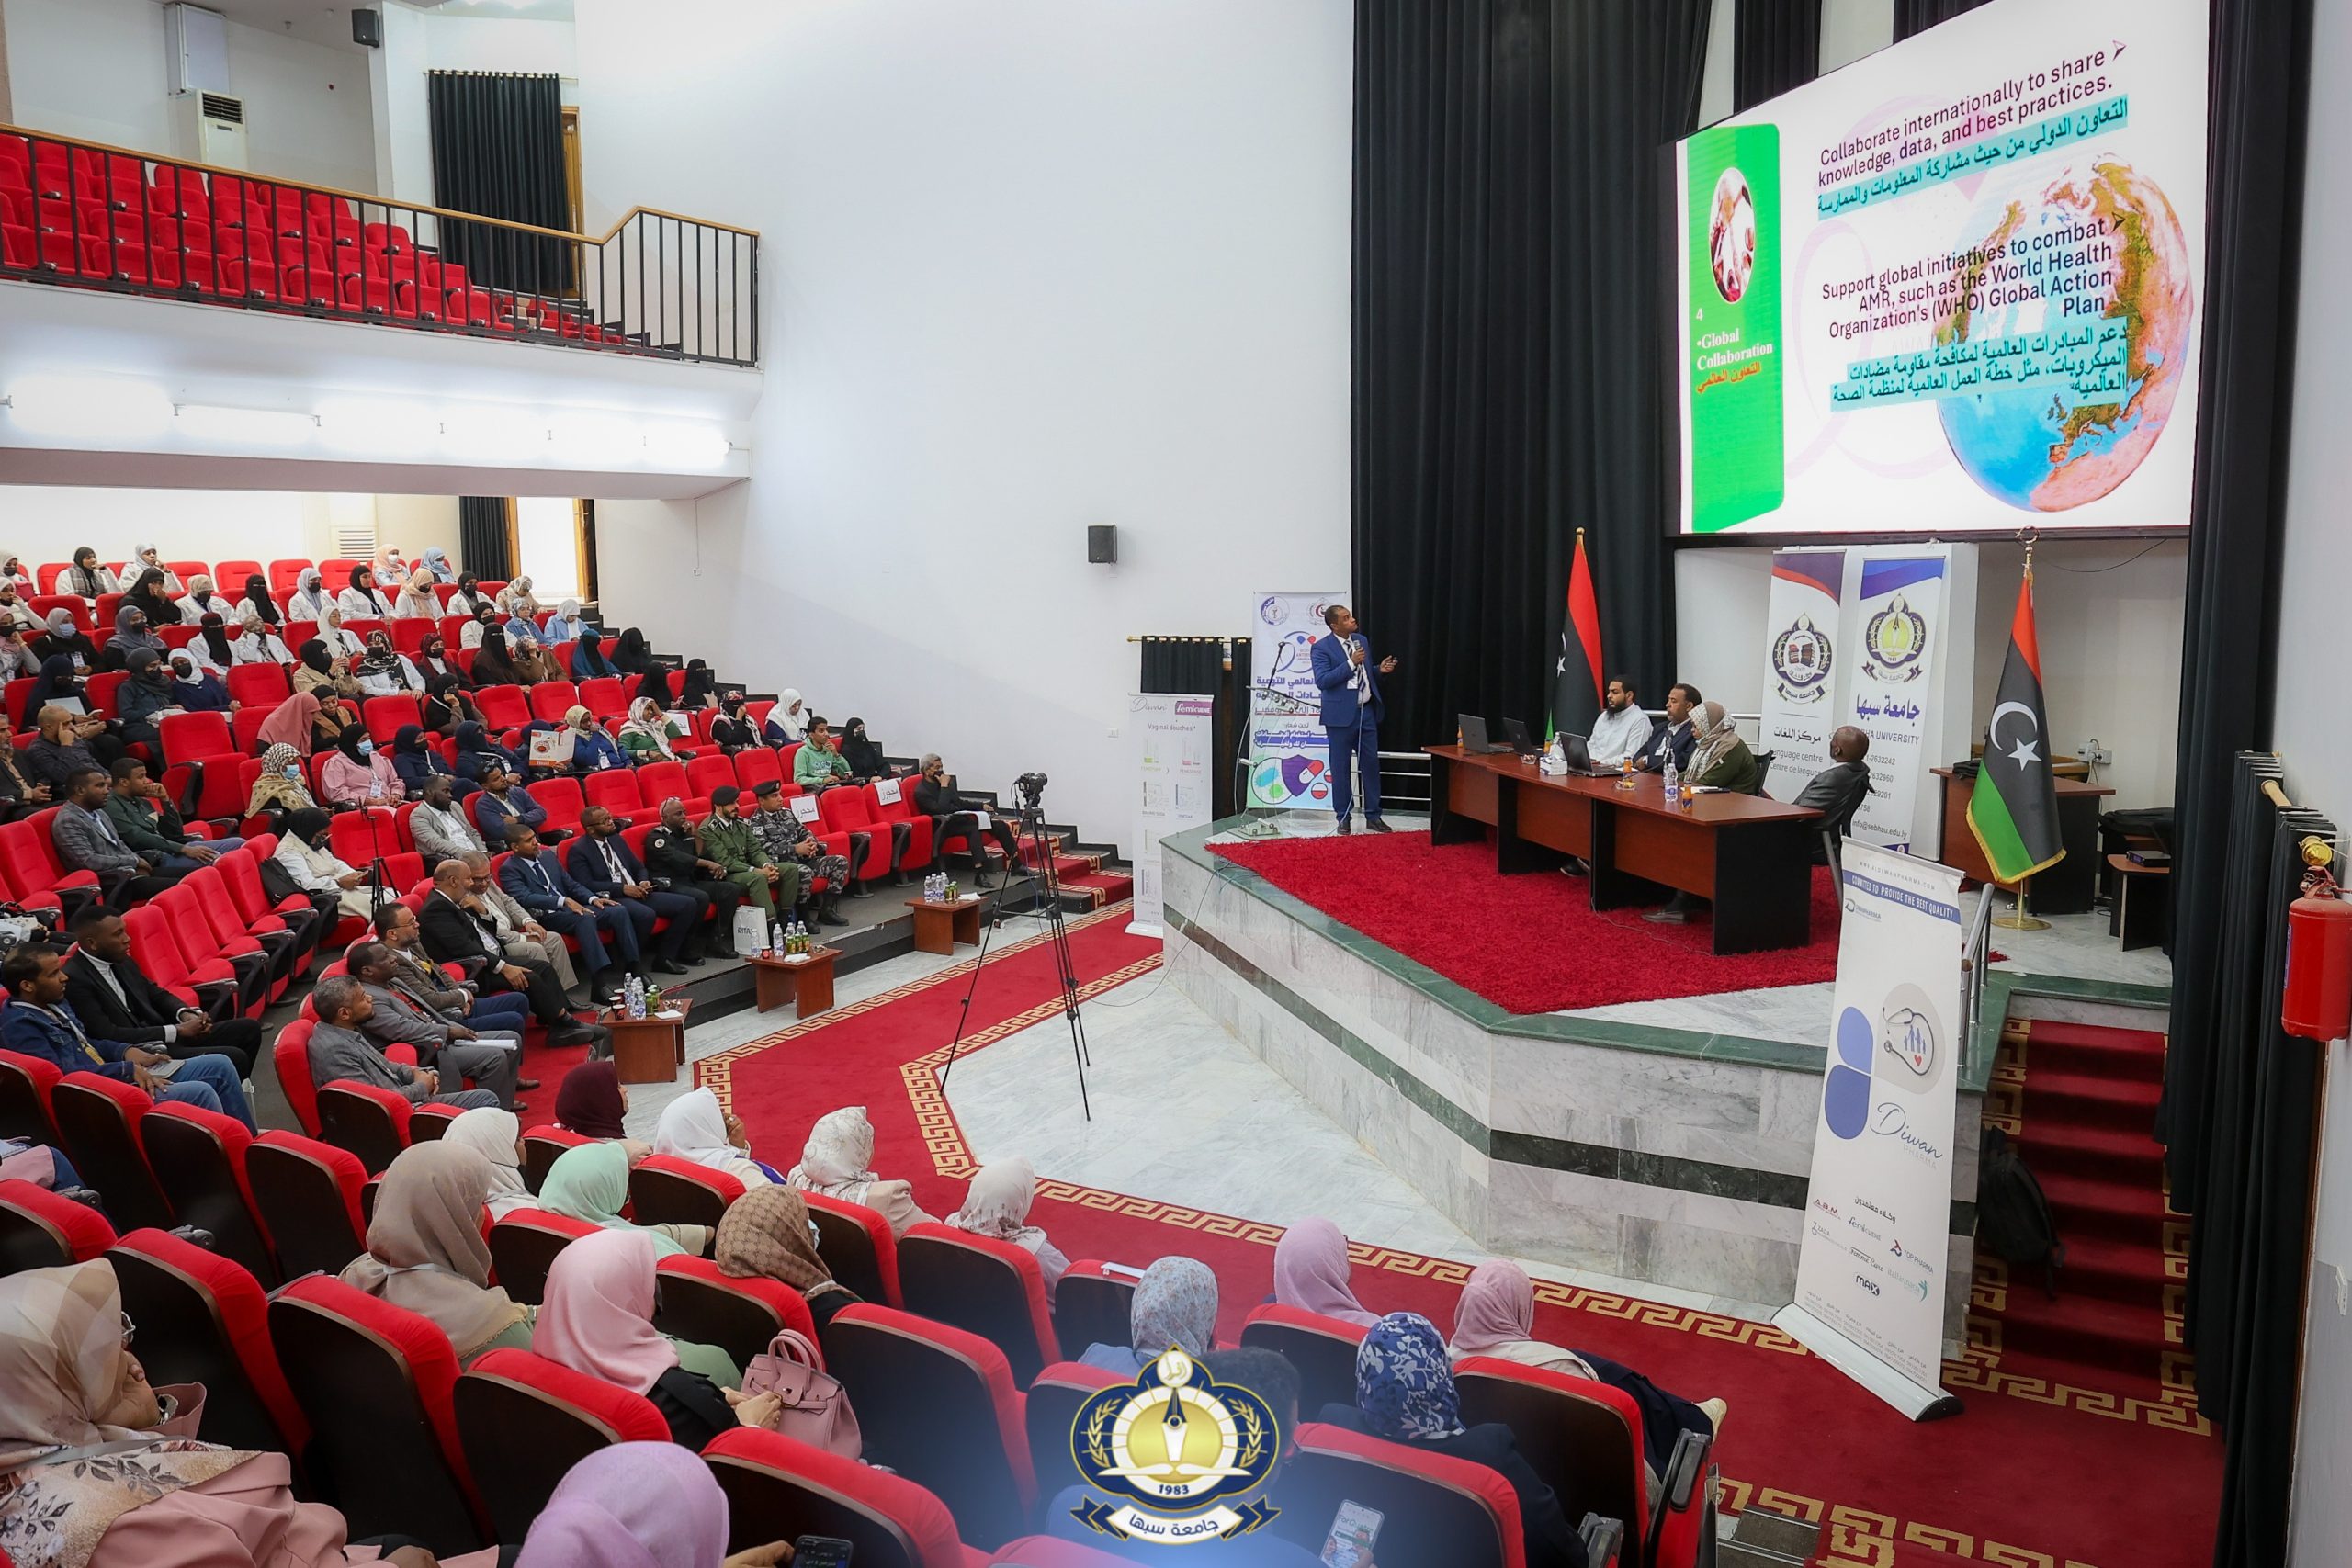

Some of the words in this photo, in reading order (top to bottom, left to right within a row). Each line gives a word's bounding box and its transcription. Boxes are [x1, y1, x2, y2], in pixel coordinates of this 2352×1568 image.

[1821, 127, 1900, 165] Collaborate
[1905, 79, 2024, 137] internationally
[2028, 73, 2045, 91] to
[2051, 51, 2105, 83] share
[2076, 97, 2128, 136] التعاون
[1818, 152, 1895, 187] knowledge,
[1899, 138, 1937, 160] data,
[1941, 118, 1972, 145] and
[1976, 106, 2013, 133] best
[2018, 75, 2112, 124] practices.
[2029, 116, 2071, 155] الدولي
[1973, 144, 2001, 164] حيث
[2006, 138, 2024, 158] من
[1926, 152, 1970, 179] مشاركة
[1871, 166, 1922, 196] المعلومات
[1822, 274, 1875, 300] Support
[1879, 261, 1923, 292] global
[1927, 244, 2006, 276] initiatives
[2010, 239, 2028, 256] to
[2032, 218, 2105, 251] combat
[1859, 289, 1894, 313] AMR,
[1899, 281, 1934, 304] such
[1939, 278, 1957, 296] as
[1962, 271, 1987, 291] the
[1992, 255, 2042, 284] World
[2048, 241, 2112, 273] Health
[1696, 308, 1703, 321] 4
[1829, 305, 1928, 340] Organization's
[1932, 291, 1984, 322] (WHO)
[1989, 278, 2046, 307] Global
[2050, 269, 2112, 297] Action
[2064, 296, 2105, 317] Plan
[2031, 326, 2093, 355] المبادرات
[2099, 324, 2127, 345] دعم
[1697, 343, 1773, 370] Collaboration
[1934, 344, 1978, 367] لمكافحة
[1982, 337, 2027, 362] العالمية
[1850, 360, 1890, 380] مضادات
[1894, 354, 1930, 377] مقاومة
[1985, 361, 2012, 381] خطة
[2017, 357, 2041, 382] مثل
[1869, 378, 1905, 398] لمنظمة
[1907, 371, 1948, 397] العالمية
[1951, 367, 1981, 391] العمل
[1833, 385, 1865, 401] الصحة
[1856, 693, 1881, 721] سبها
[1883, 694, 1920, 727] جامعة
[1773, 726, 1795, 739] اللغات
[1795, 729, 1821, 745] مركز
[1876, 731, 1920, 745] UNIVERSITY
[1801, 752, 1824, 763] centre
[1797, 766, 1821, 777] langue
[1852, 819, 1908, 840] info@sebhau.edu.ly
[1881, 886, 1904, 902] PROVIDE
[1905, 894, 1916, 907] THE
[1917, 897, 1928, 911] BEST
[1929, 903, 1954, 919] QUALITY
[1870, 1102, 1943, 1159] Diwan
